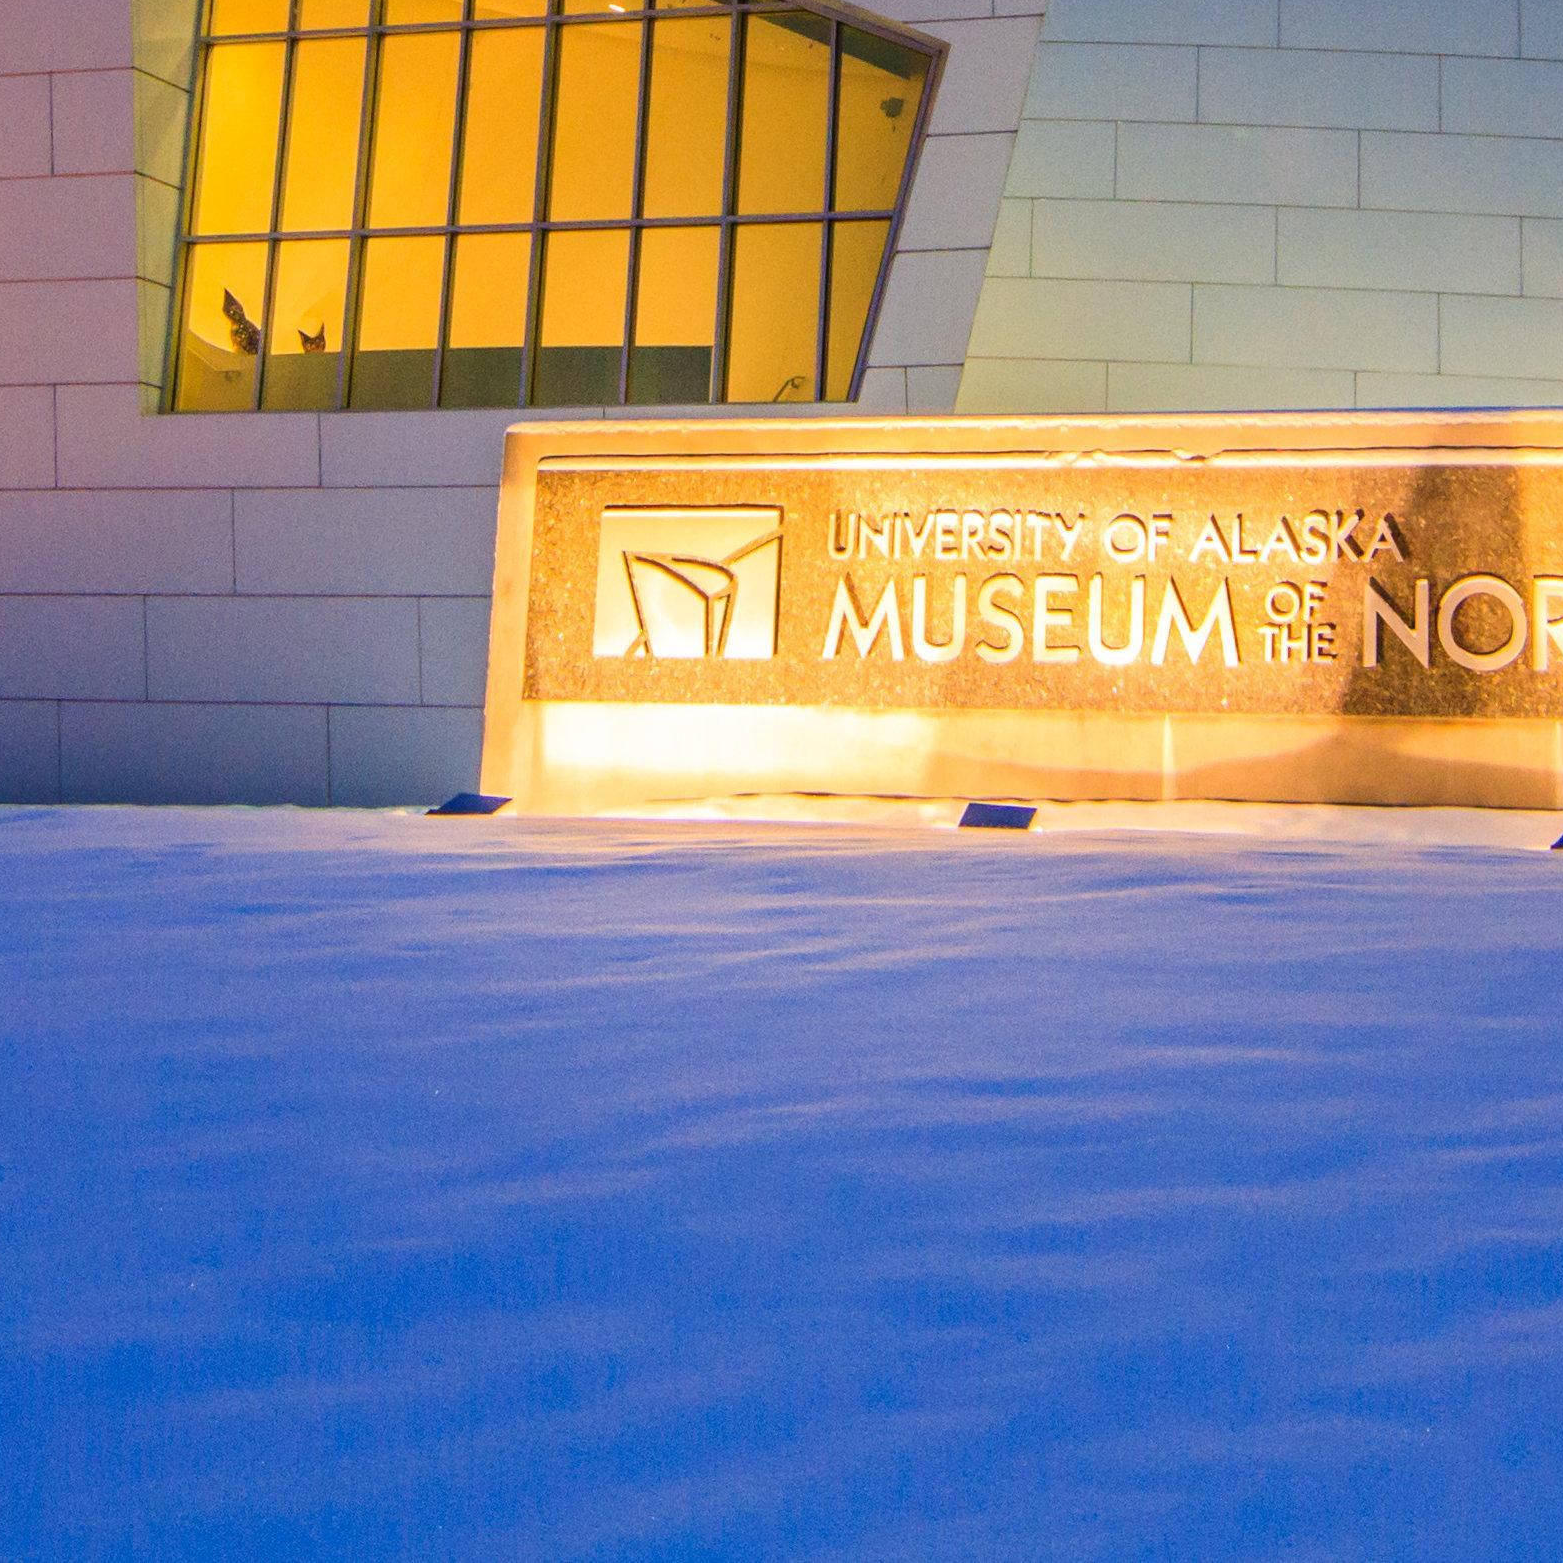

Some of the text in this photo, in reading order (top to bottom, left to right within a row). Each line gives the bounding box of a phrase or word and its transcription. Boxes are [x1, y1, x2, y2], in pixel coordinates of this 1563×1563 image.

[827, 509, 1407, 564] UNIVERSITY OF ALASKA
[822, 572, 1240, 668] MUSEUM
[1264, 581, 1327, 623] OF
[1258, 623, 1337, 664] THE
